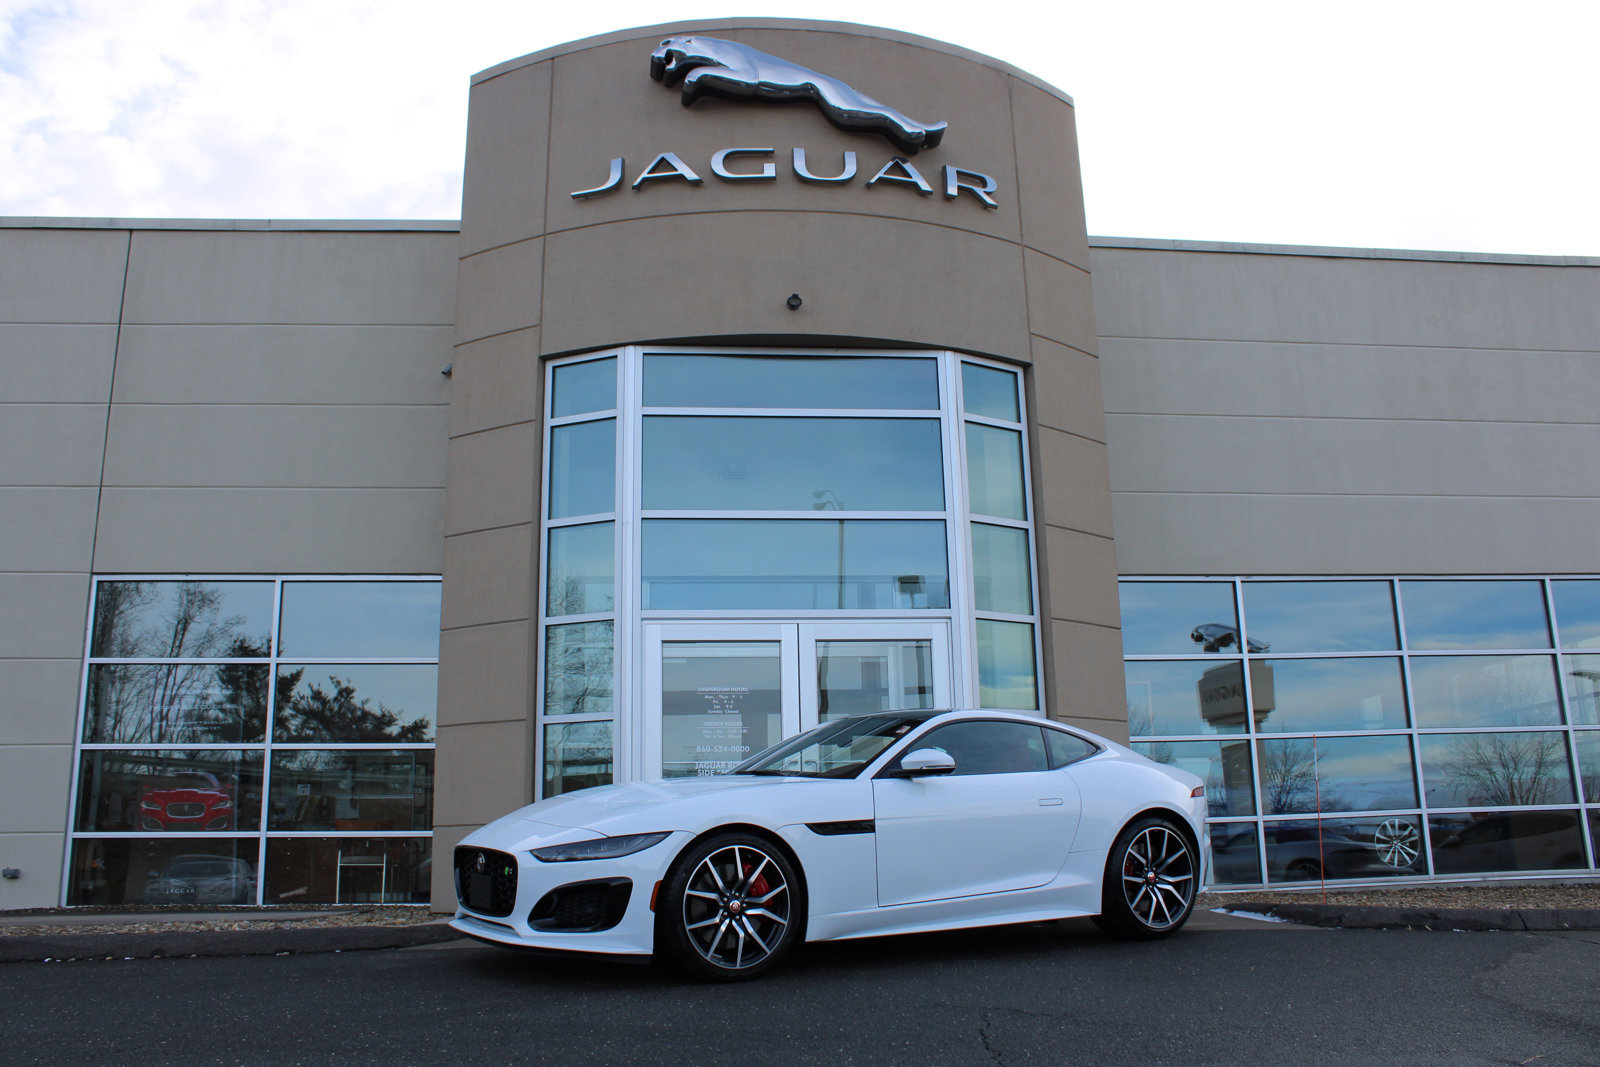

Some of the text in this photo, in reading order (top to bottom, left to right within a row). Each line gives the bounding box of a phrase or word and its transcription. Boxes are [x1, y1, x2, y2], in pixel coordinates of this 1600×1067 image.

[571, 147, 998, 209] JAGUAR
[696, 745, 750, 753] 860-524-0000
[697, 769, 715, 777] SIDE
